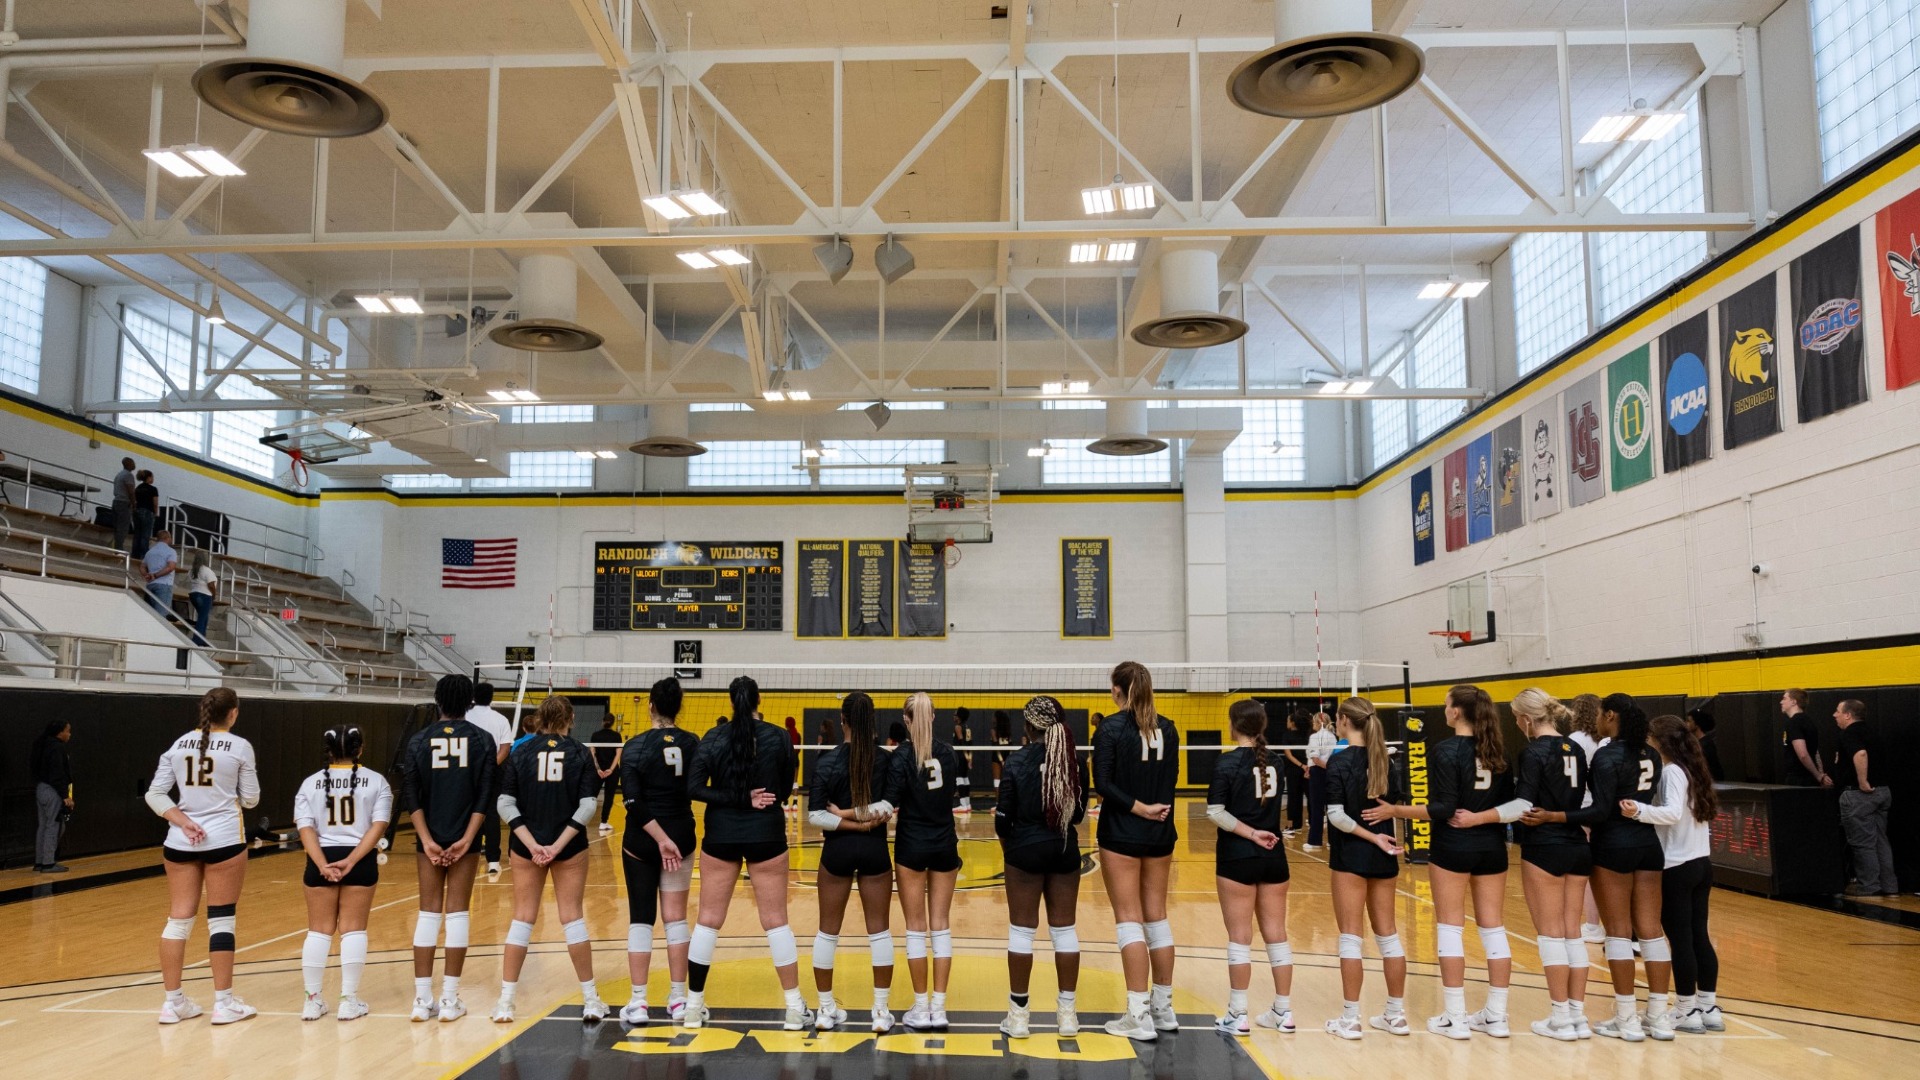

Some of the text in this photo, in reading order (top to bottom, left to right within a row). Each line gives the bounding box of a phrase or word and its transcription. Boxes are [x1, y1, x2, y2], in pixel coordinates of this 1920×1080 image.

[1800, 299, 1861, 349] ODAC
[1670, 385, 1707, 420] NCAA
[1734, 386, 1776, 415] RANDOLPH
[1621, 398, 1643, 441] H
[598, 546, 779, 561] RANDOLPH WILDCATS
[802, 543, 840, 551] ALL-AMERICANS
[857, 549, 885, 557] QUALIFIERS
[610, 566, 615, 574] F
[618, 566, 631, 574] PTS
[761, 566, 766, 574] F
[769, 566, 782, 574] PTS
[177, 739, 232, 752] RANDLPH
[430, 737, 469, 769] 24
[1139, 728, 1164, 761] 14
[184, 755, 214, 787] 12
[537, 751, 565, 782] 16
[663, 746, 683, 776] 9
[923, 758, 944, 790] 3
[1562, 755, 1578, 788] 4
[1637, 759, 1654, 791] 2
[1252, 765, 1278, 799] 13
[327, 795, 355, 826] 10
